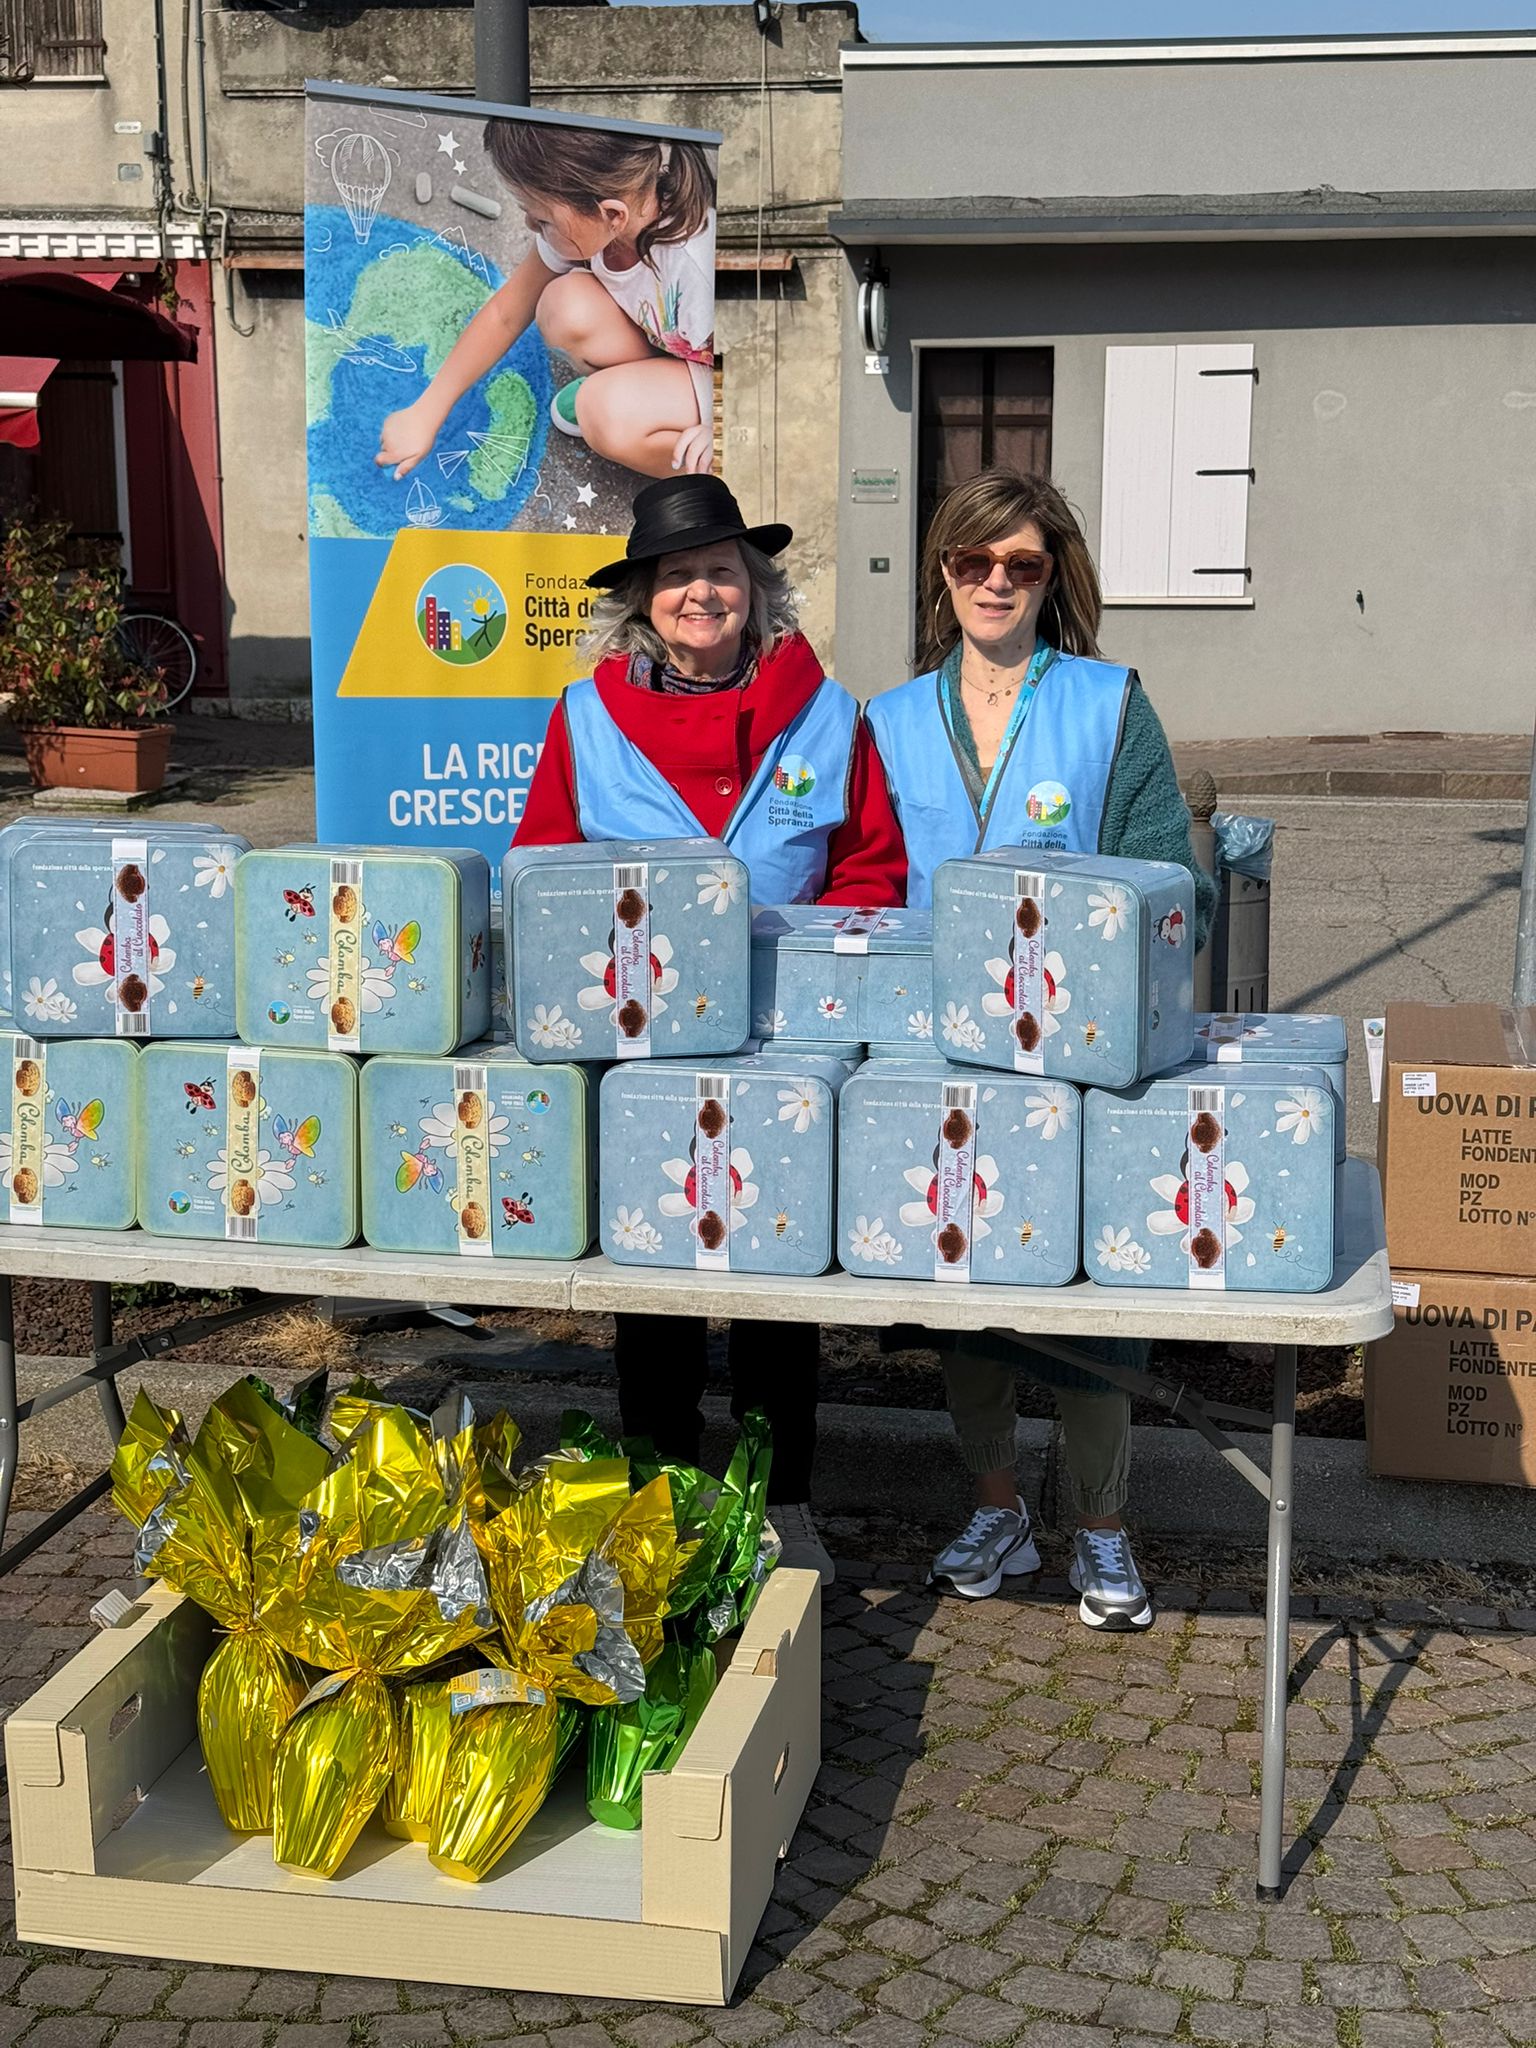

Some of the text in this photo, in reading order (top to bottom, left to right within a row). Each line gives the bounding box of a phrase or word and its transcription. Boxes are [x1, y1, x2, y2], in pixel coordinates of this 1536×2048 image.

[525, 573, 590, 590] Fondaz
[524, 596, 570, 618] Città
[423, 743, 468, 780] LA
[389, 788, 528, 826] CRESCE
[768, 806, 814, 819] Città della
[769, 797, 813, 810] Fondazione
[768, 816, 814, 828] Speranza
[1022, 830, 1068, 840] Fondazione
[1022, 839, 1066, 850] Città della
[131, 903, 144, 958] al Cioccolato
[120, 936, 134, 973] Colomba
[334, 928, 356, 994] Colomba
[632, 929, 644, 966] Colomba
[1028, 940, 1040, 978] Colomba
[620, 945, 632, 1000] al Cioccolato
[1018, 955, 1029, 1010] al Cioccolato
[1417, 1092, 1488, 1116] UOVA
[1496, 1094, 1520, 1118] DI
[16, 1102, 40, 1166] Colomba
[230, 1110, 254, 1174] Colomba
[1462, 1128, 1512, 1145] LATTE
[460, 1134, 484, 1198] Colomba
[712, 1140, 724, 1176] Colomba
[956, 1150, 970, 1188] Colomba
[1461, 1146, 1536, 1164] FONDENT
[700, 1155, 712, 1210] al Cioccolato
[1206, 1154, 1220, 1193] Colomba
[1460, 1173, 1500, 1190] MOD
[942, 1166, 955, 1222] al Cioccolato
[1194, 1171, 1207, 1228] al Cioccolato
[1460, 1190, 1482, 1206] PZ
[1459, 1208, 1536, 1226] LOTTO N°
[1405, 1304, 1536, 1332] UOVA DI P
[1450, 1340, 1500, 1358] LATTE
[1450, 1358, 1536, 1377] FONDENTE
[1448, 1385, 1488, 1401] MOD
[1448, 1402, 1470, 1418] PZ
[1448, 1419, 1523, 1438] LOTTO N°
